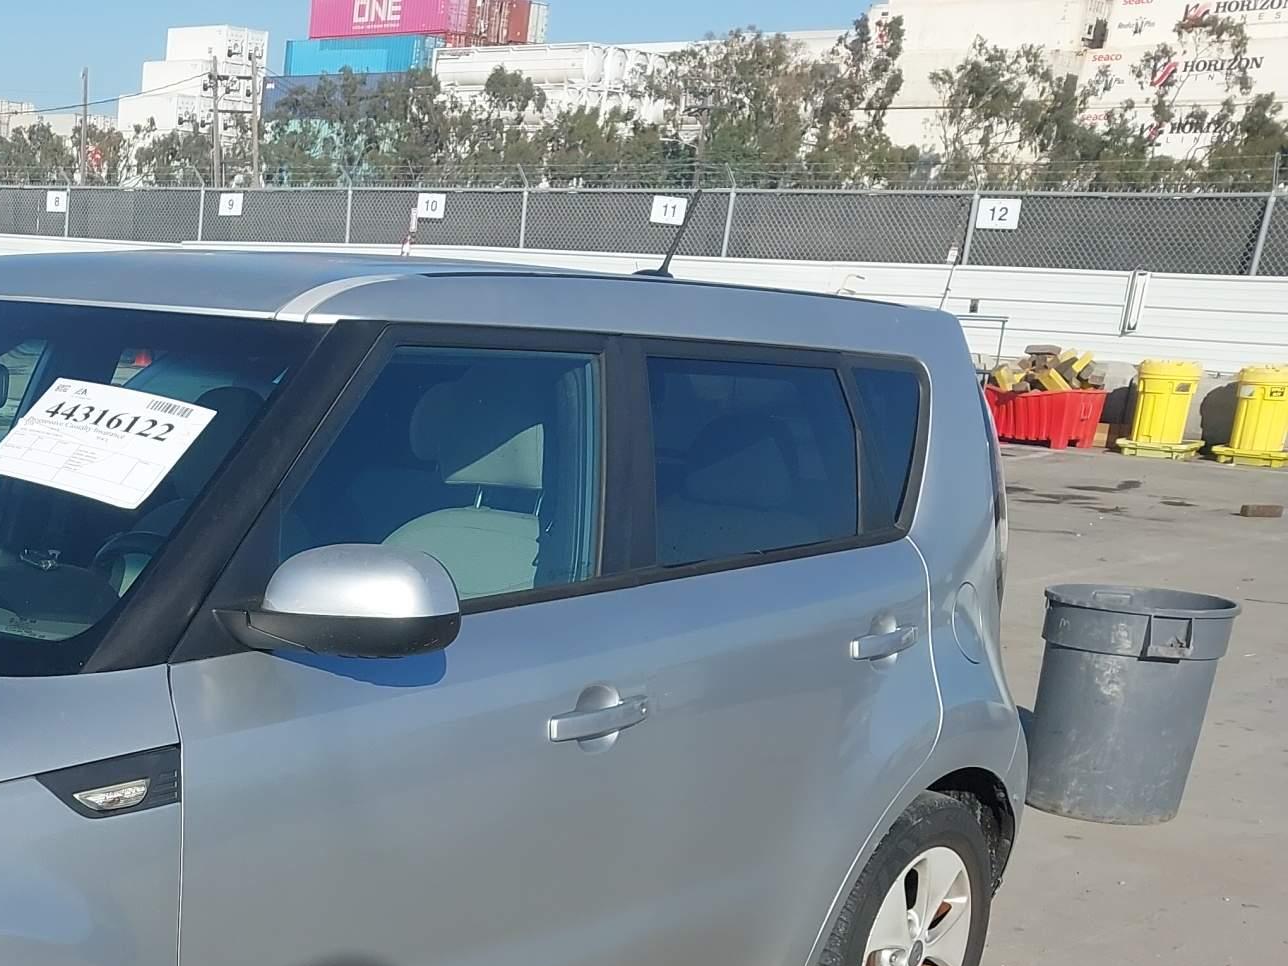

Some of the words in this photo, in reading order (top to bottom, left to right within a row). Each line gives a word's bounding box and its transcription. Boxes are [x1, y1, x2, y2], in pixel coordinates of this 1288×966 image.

[353, 0, 402, 22] ONE
[1092, 53, 1122, 62] seaco
[1182, 56, 1265, 73] HORIZON
[54, 196, 60, 207] 8
[227, 198, 235, 210] 9
[425, 199, 438, 212] 10
[663, 203, 677, 218] 11
[988, 205, 1010, 222] 12
[44, 400, 176, 442] 44316122
